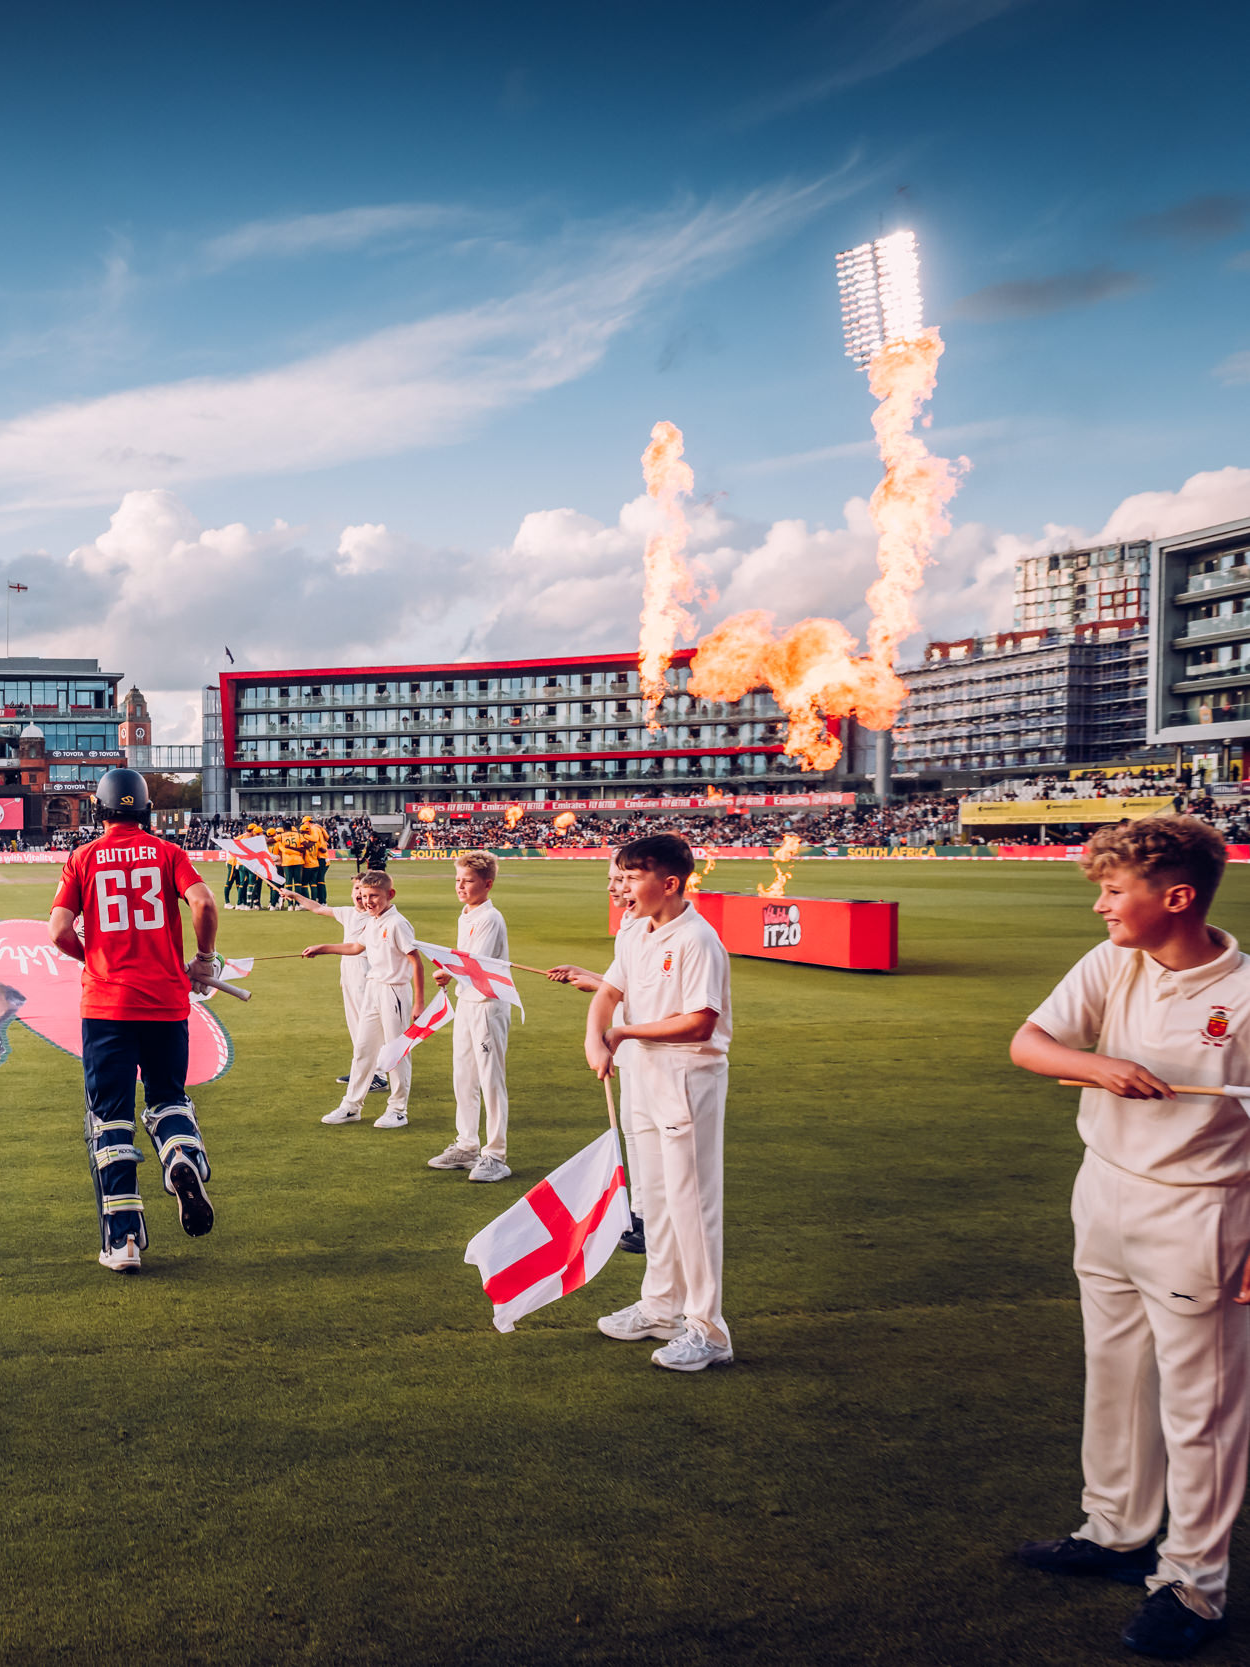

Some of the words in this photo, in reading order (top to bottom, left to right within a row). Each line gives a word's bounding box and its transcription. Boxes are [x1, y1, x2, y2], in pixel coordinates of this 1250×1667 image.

[412, 804, 445, 812] Emtes
[552, 801, 586, 810] Emirates
[96, 845, 157, 865] BUTTLER
[410, 849, 447, 858] SOUTH
[847, 847, 887, 857] SOUTH
[890, 846, 937, 857] AFRICA
[5, 853, 21, 862] with
[95, 867, 164, 932] 63
[763, 922, 801, 947] IT20
